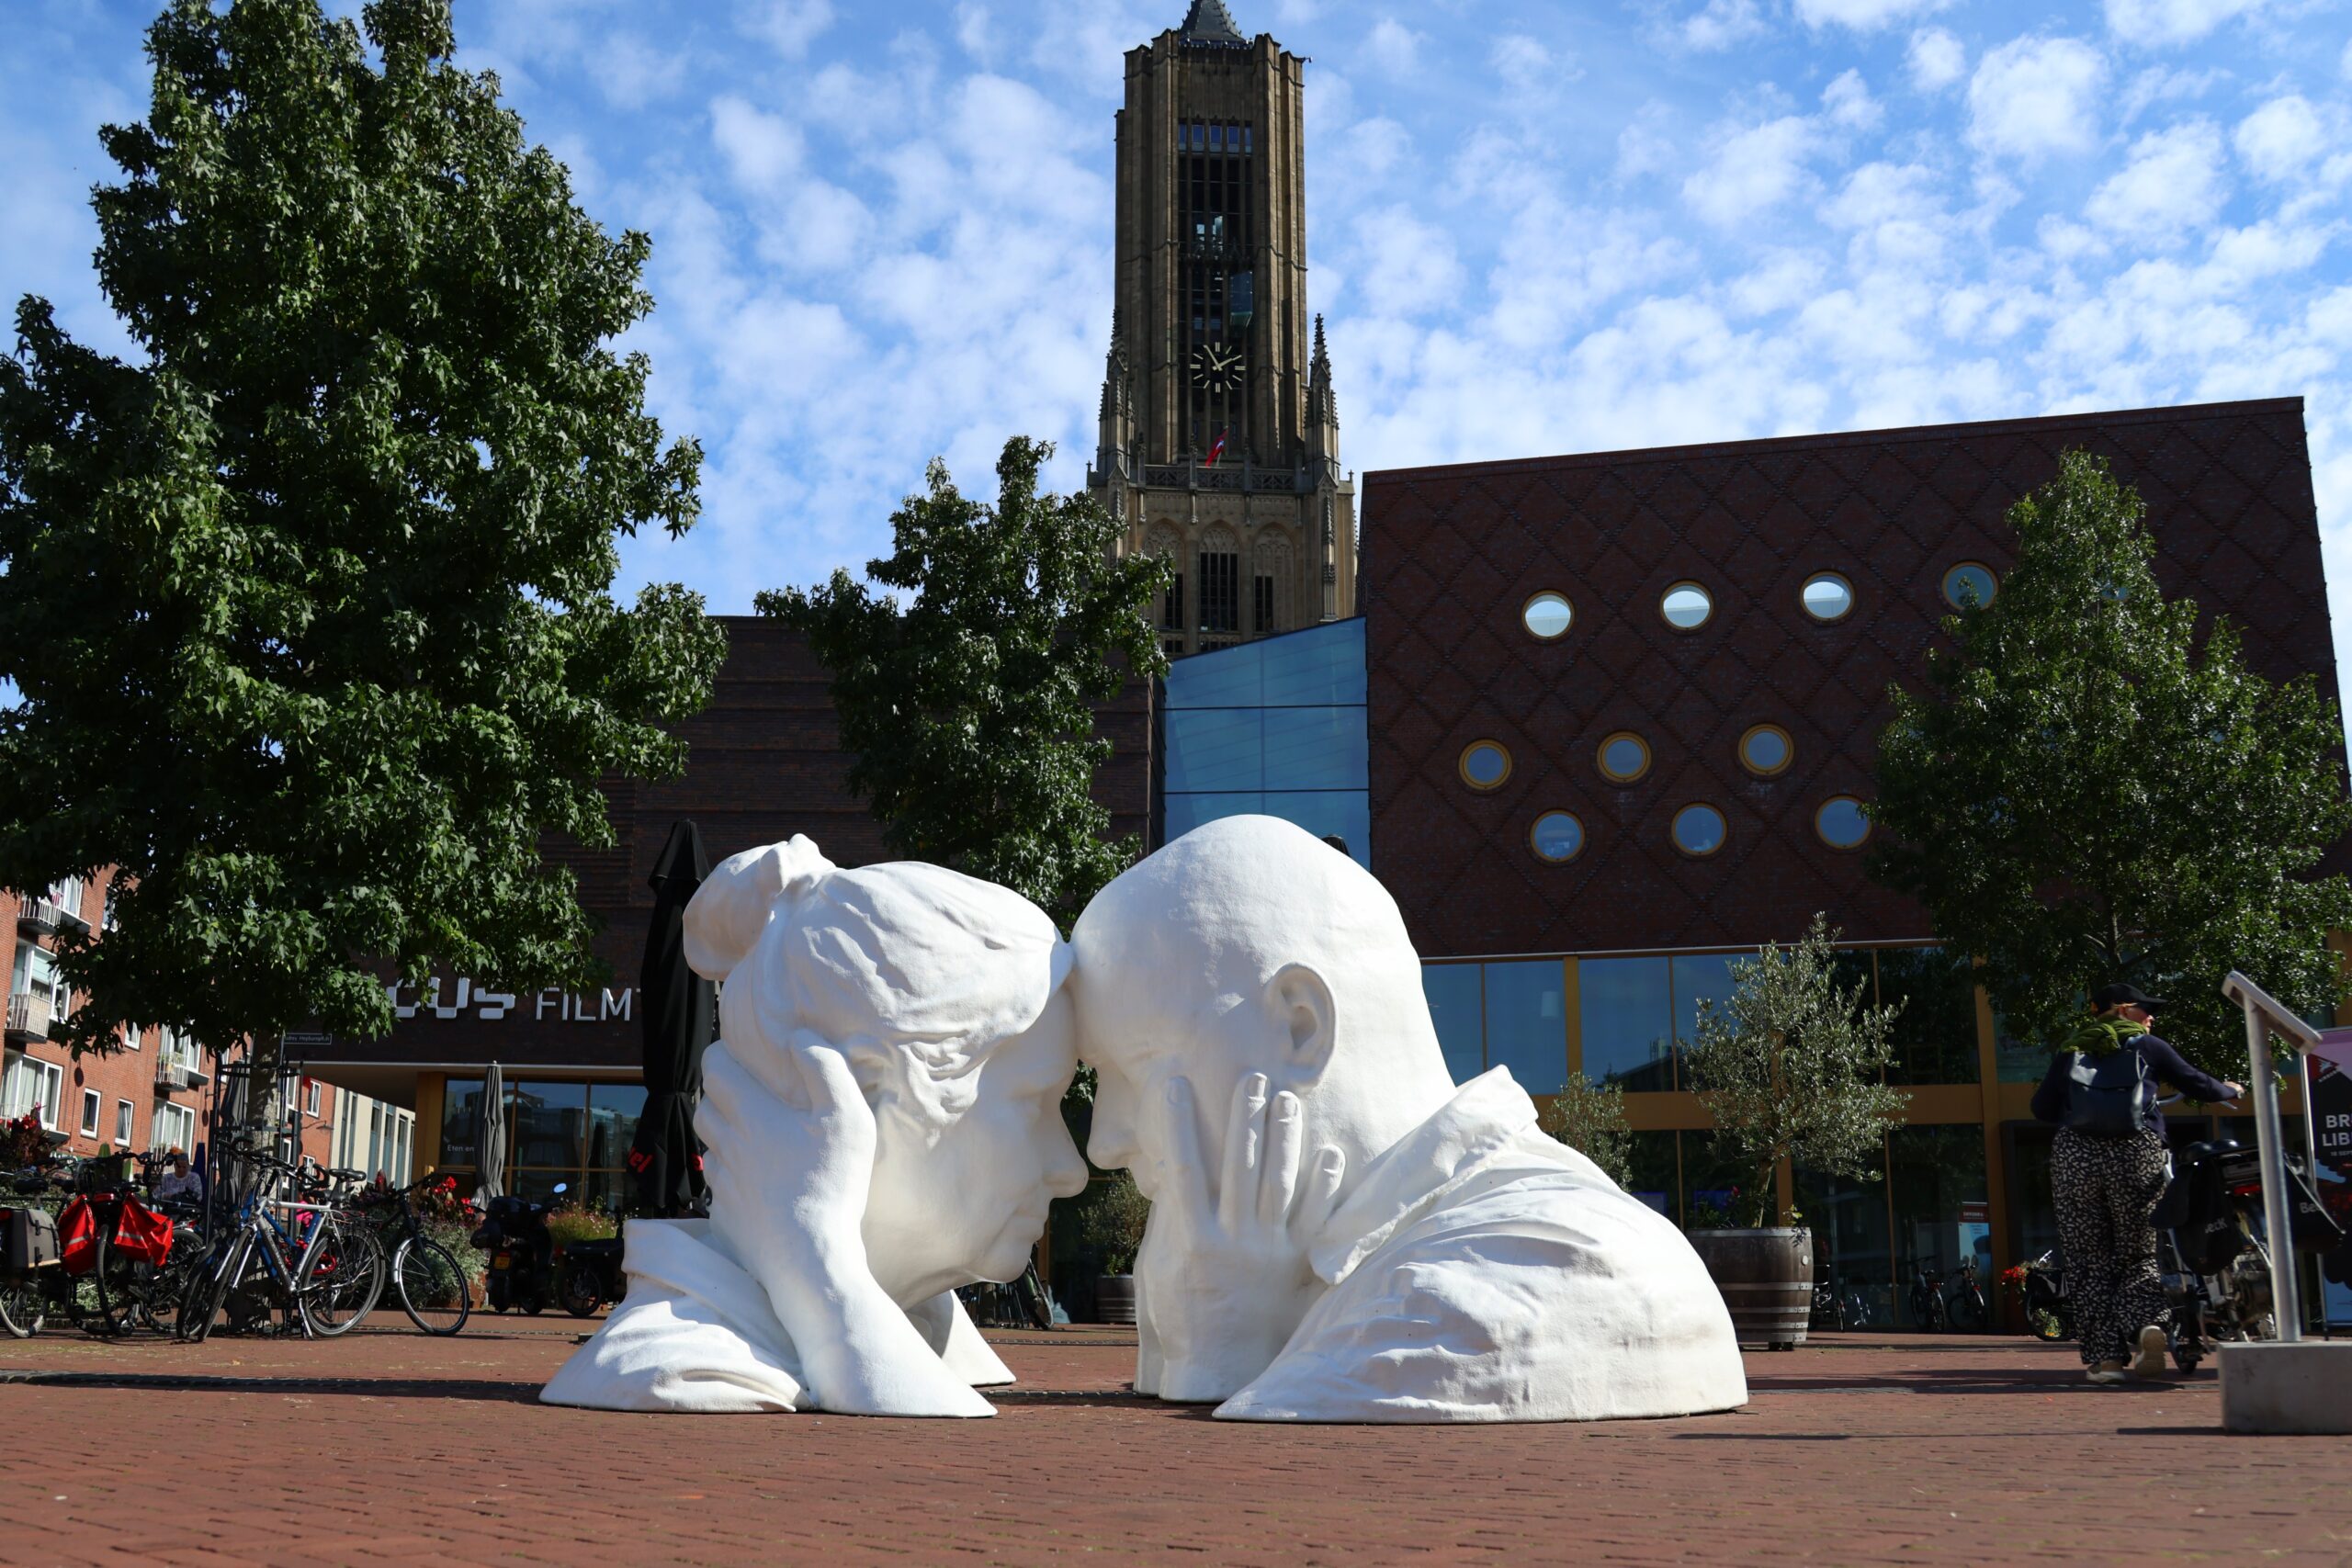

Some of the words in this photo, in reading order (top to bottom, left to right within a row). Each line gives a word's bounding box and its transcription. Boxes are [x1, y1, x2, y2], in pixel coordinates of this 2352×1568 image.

[386, 976, 516, 1019] CUS
[536, 987, 641, 1021] FILM
[2325, 1114, 2352, 1128] BR
[2322, 1132, 2352, 1146] LIB
[2205, 1216, 2227, 1234] eck
